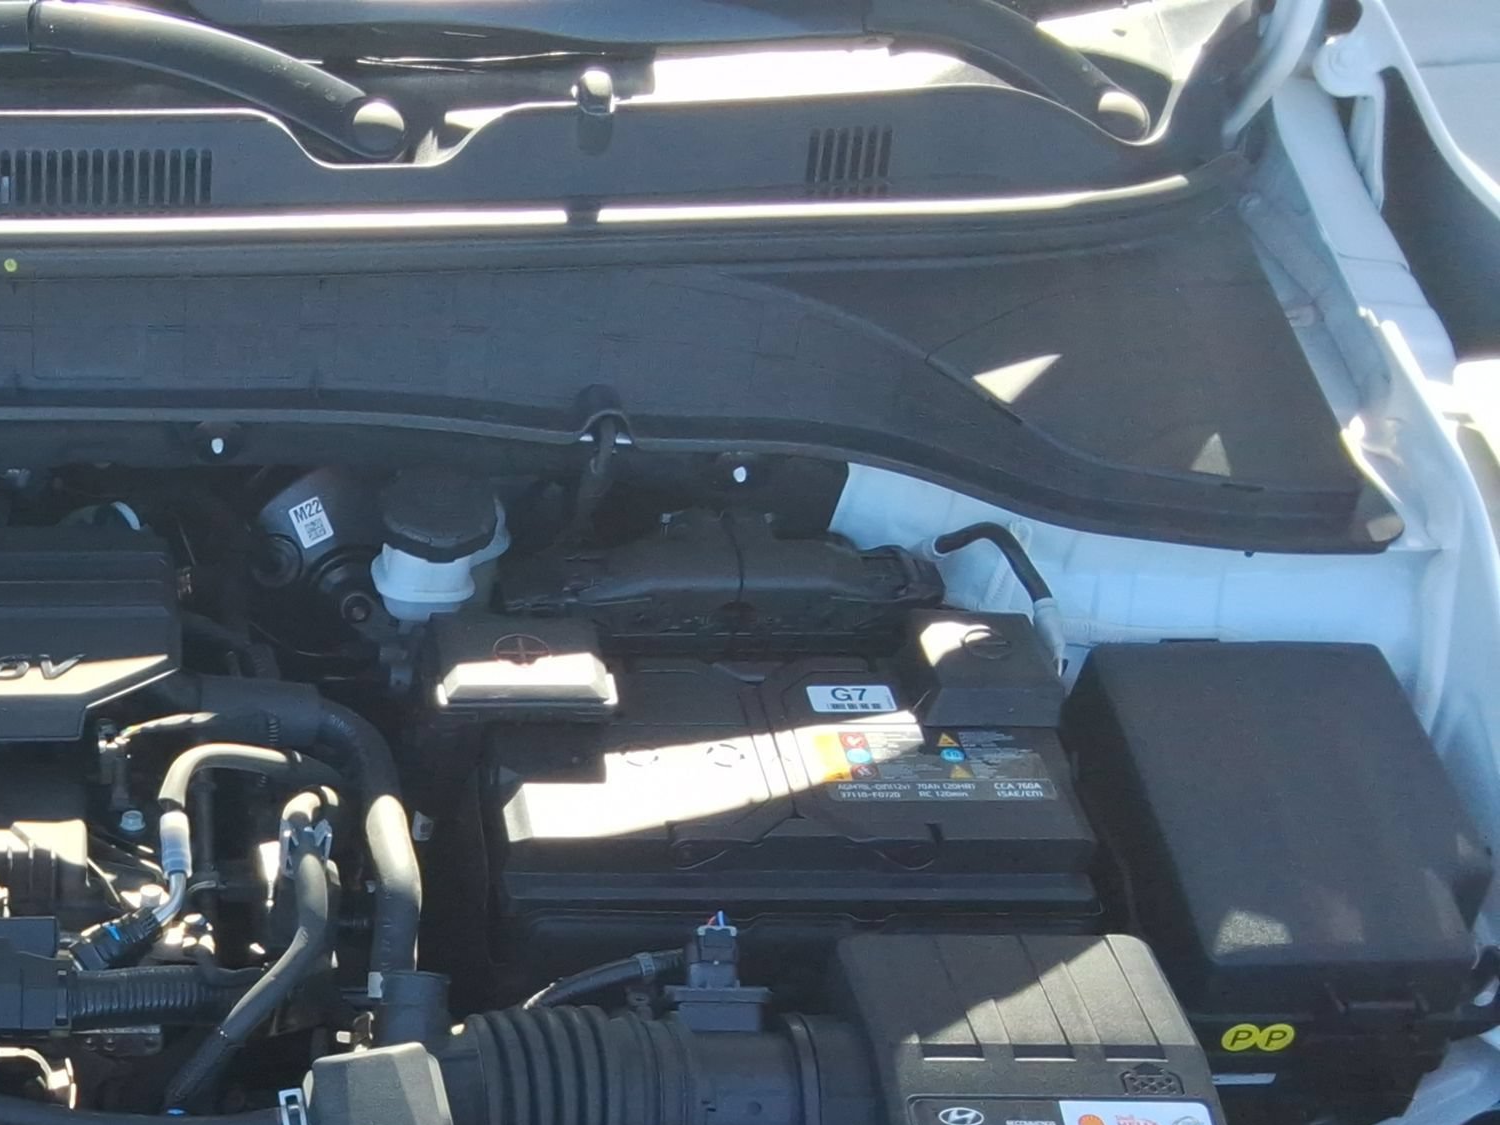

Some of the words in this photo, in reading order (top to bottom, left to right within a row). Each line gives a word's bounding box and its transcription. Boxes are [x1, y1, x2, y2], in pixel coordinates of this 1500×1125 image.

[293, 500, 324, 523] M22
[830, 687, 867, 702] G7
[994, 782, 1014, 790] CCA
[1016, 782, 1042, 790] 760A
